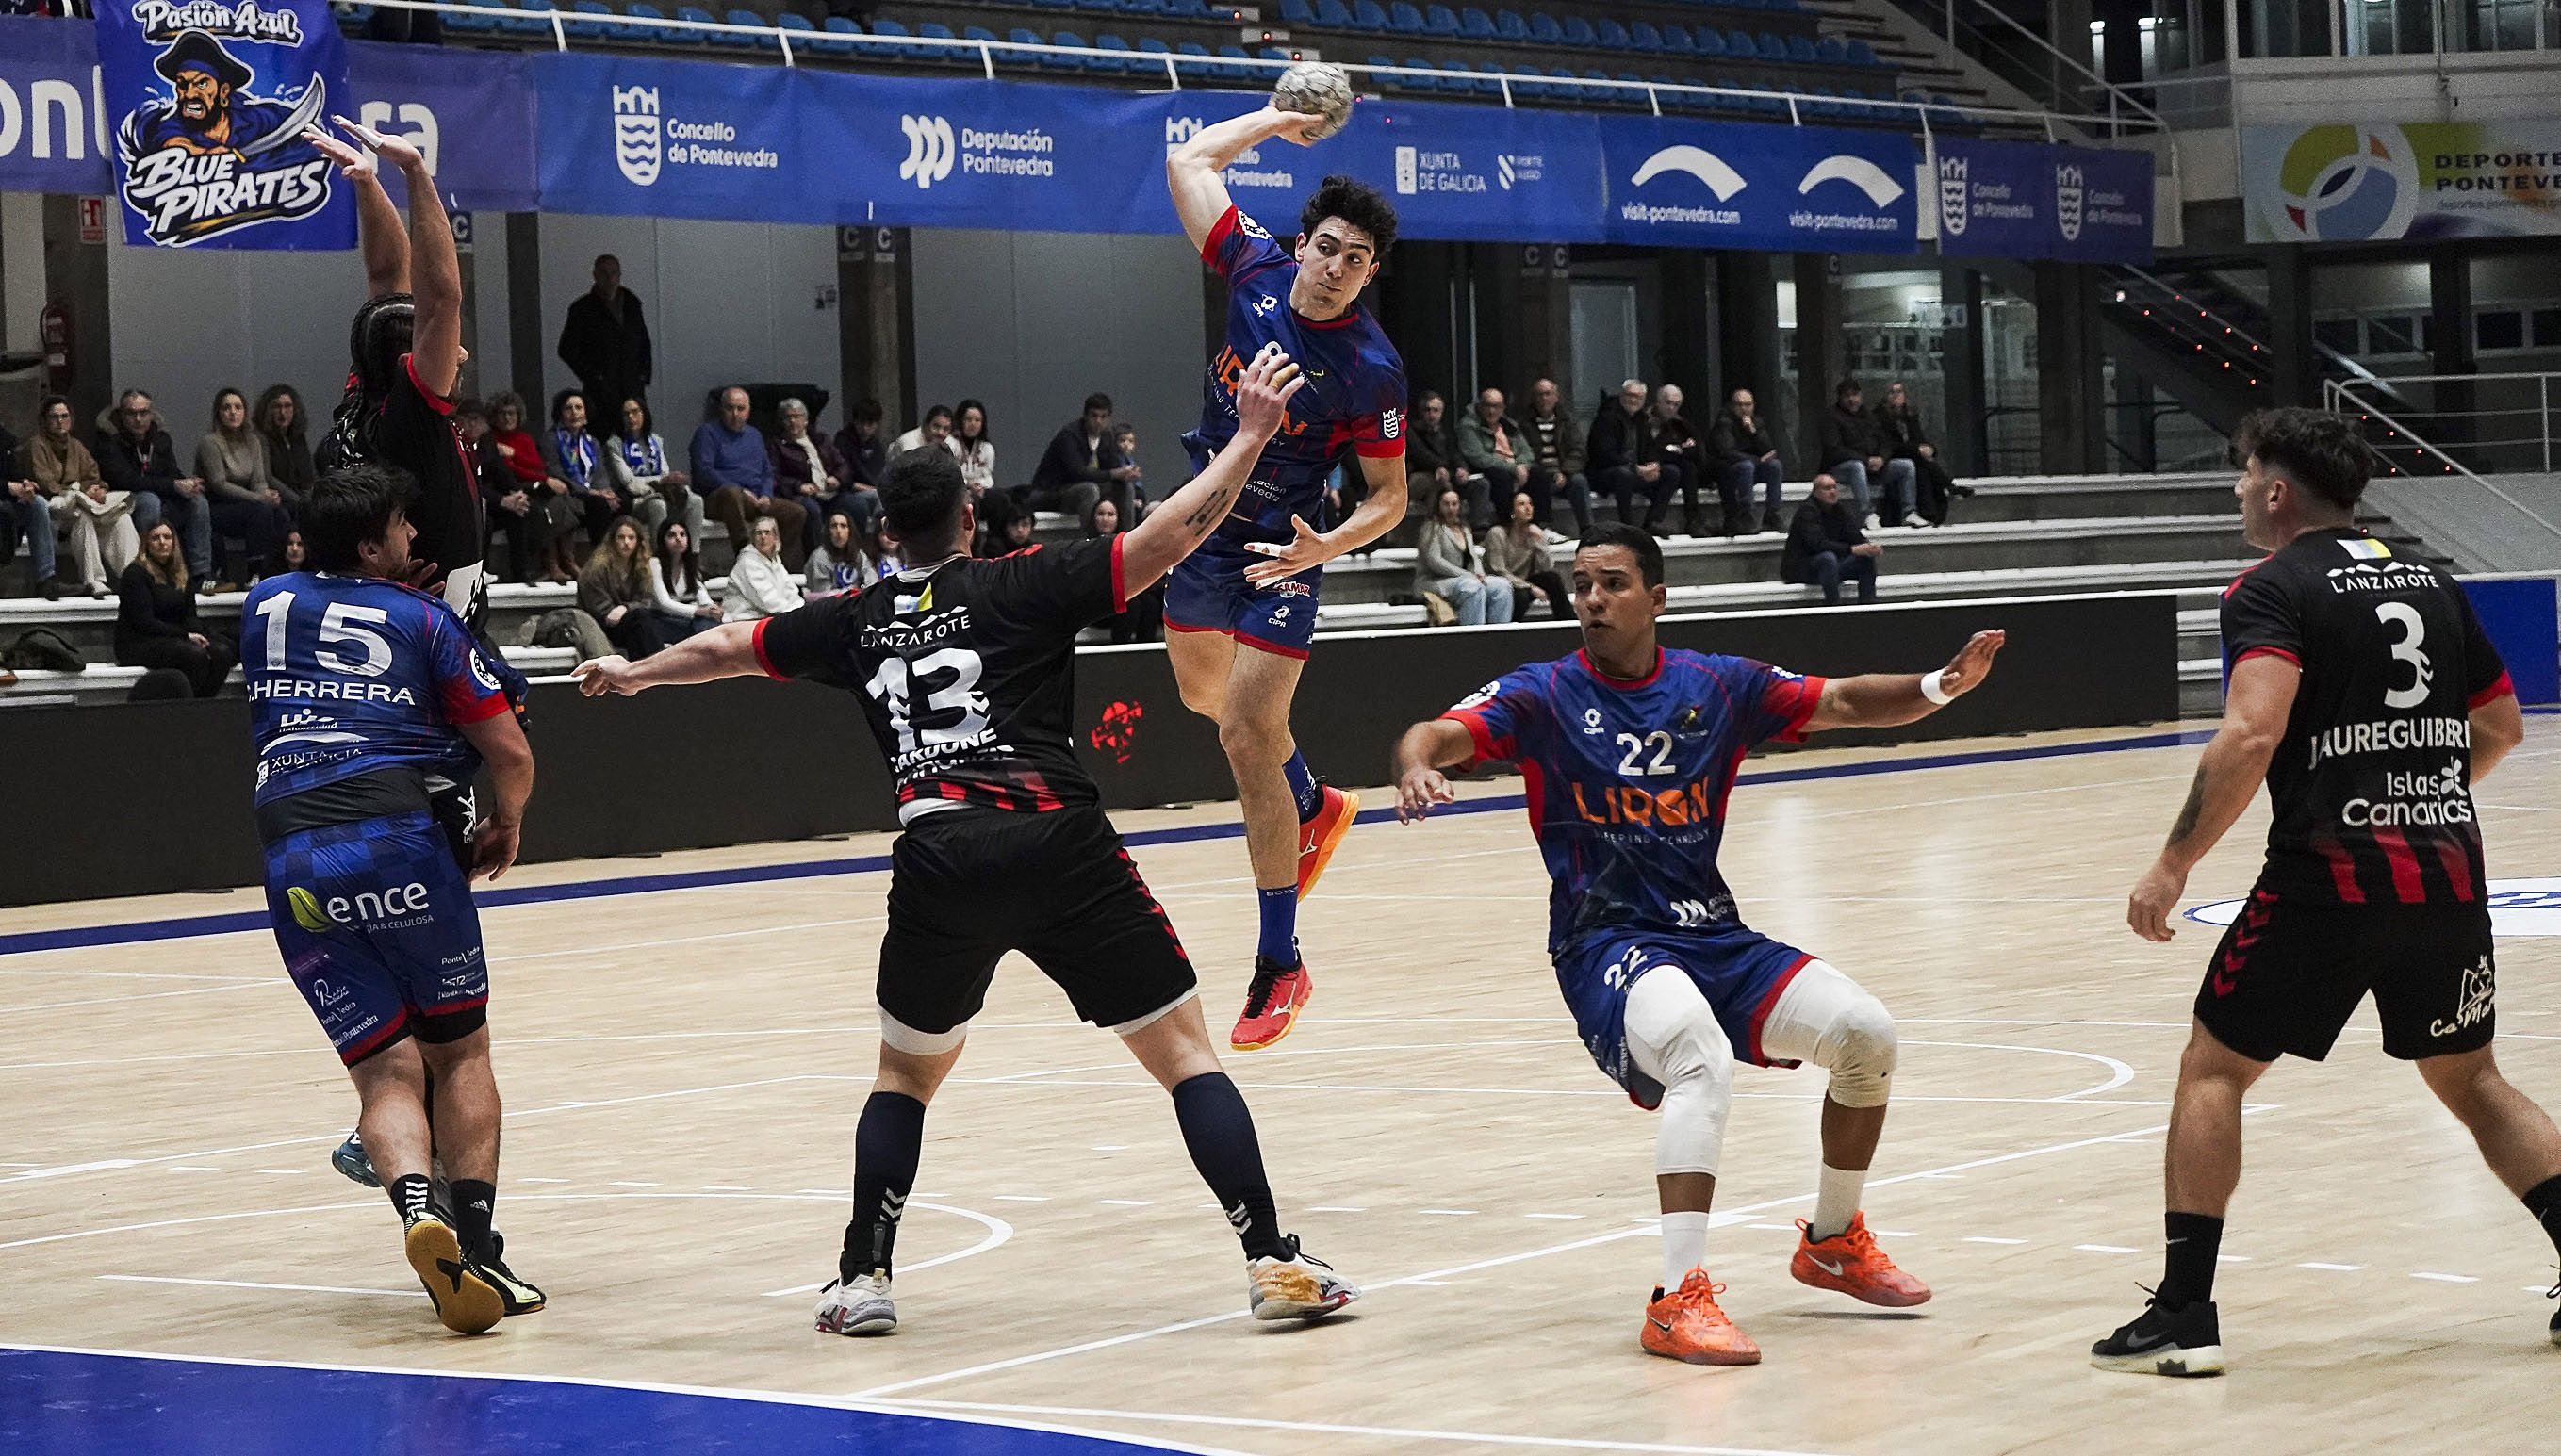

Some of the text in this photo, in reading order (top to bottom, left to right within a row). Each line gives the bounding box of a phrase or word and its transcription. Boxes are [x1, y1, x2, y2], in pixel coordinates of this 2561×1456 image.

[138, 3, 298, 39] Pasión Azul
[666, 118, 736, 142] Concello
[961, 127, 1053, 155] Deputación
[667, 143, 779, 168] de Pontevedra
[962, 153, 1054, 177] Pontevedra
[1419, 152, 1461, 171] XUNTA
[131, 146, 237, 198] BLUE
[1227, 167, 1293, 188] Pontevedra
[1419, 172, 1487, 192] DE GALICIA
[155, 160, 324, 232] PIRATES
[1621, 202, 1742, 224] visit-pontevedra.com
[1789, 209, 1899, 232] visit-pontevedra.com
[2330, 573, 2439, 594] LANZAROTE
[255, 590, 393, 678] 15
[860, 614, 972, 648] LANZAROTE
[2374, 601, 2432, 709] 3
[865, 647, 991, 754] 13
[1616, 730, 1676, 776] 22
[2387, 771, 2439, 796] Islas
[326, 882, 429, 923] ence
[387, 913, 435, 929] CELULOSA
[1603, 945, 1649, 991] 22
